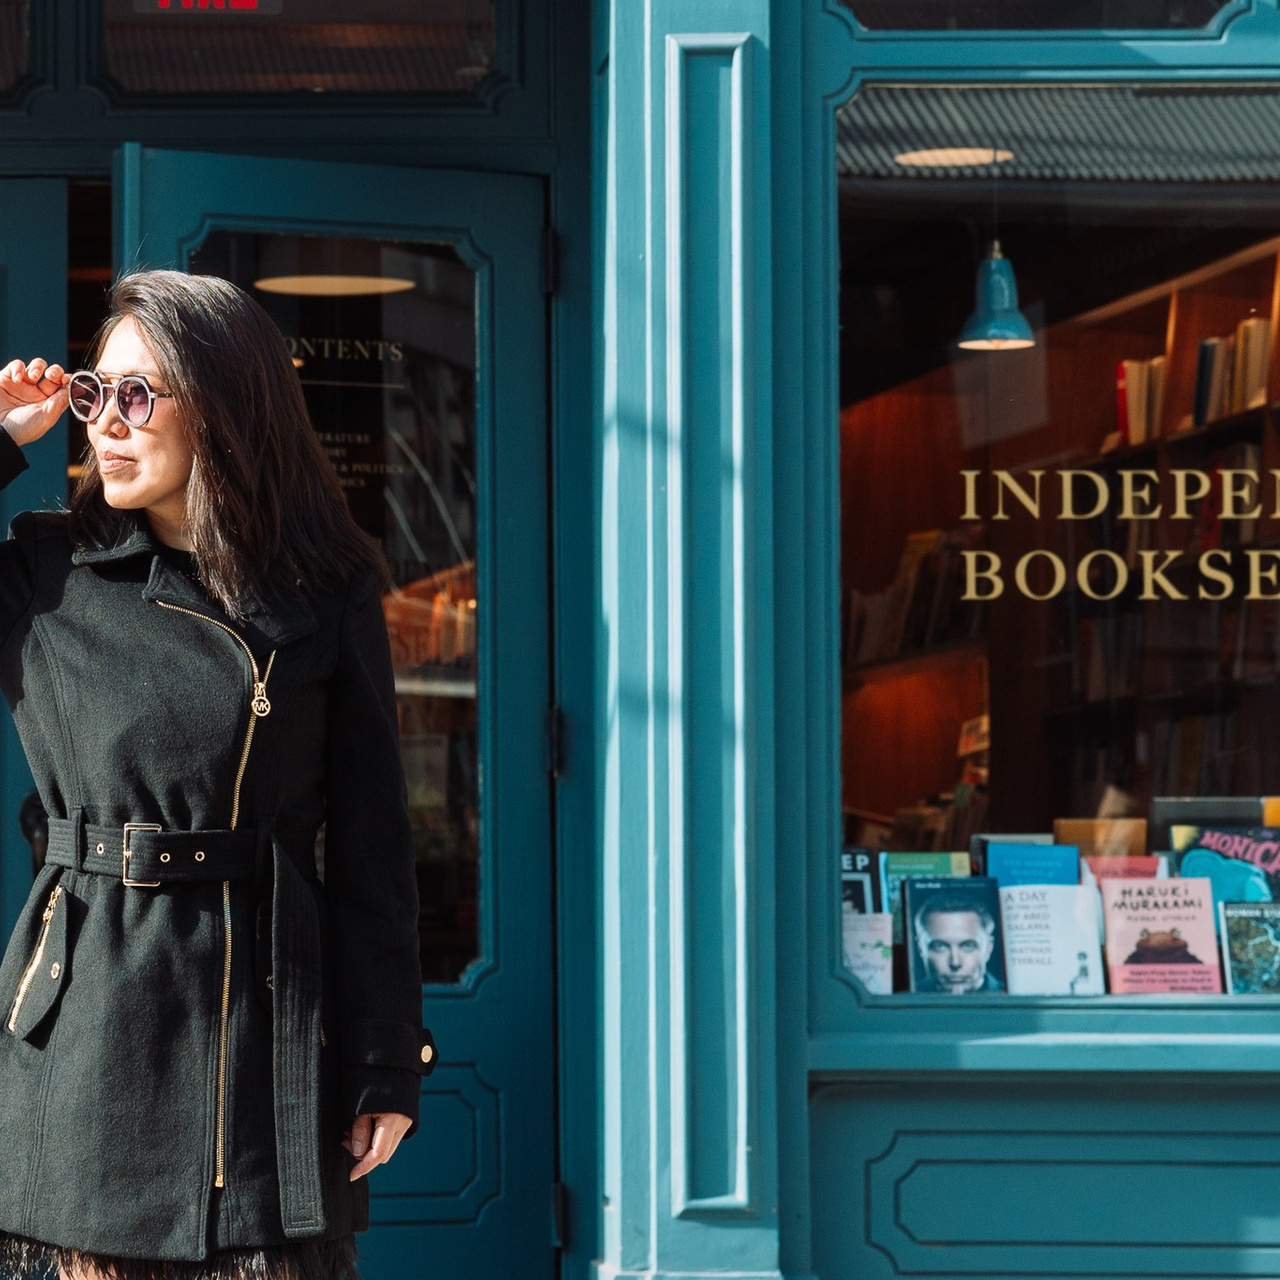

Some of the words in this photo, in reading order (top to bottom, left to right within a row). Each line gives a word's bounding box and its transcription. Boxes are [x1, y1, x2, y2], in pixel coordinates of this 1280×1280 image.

[283, 334, 404, 362] ONTENTS
[960, 469, 1280, 520] INDEPE
[960, 549, 1280, 600] BOOKSE
[1120, 884, 1189, 898] HARUKI
[1111, 900, 1203, 912] MURAKAMI
